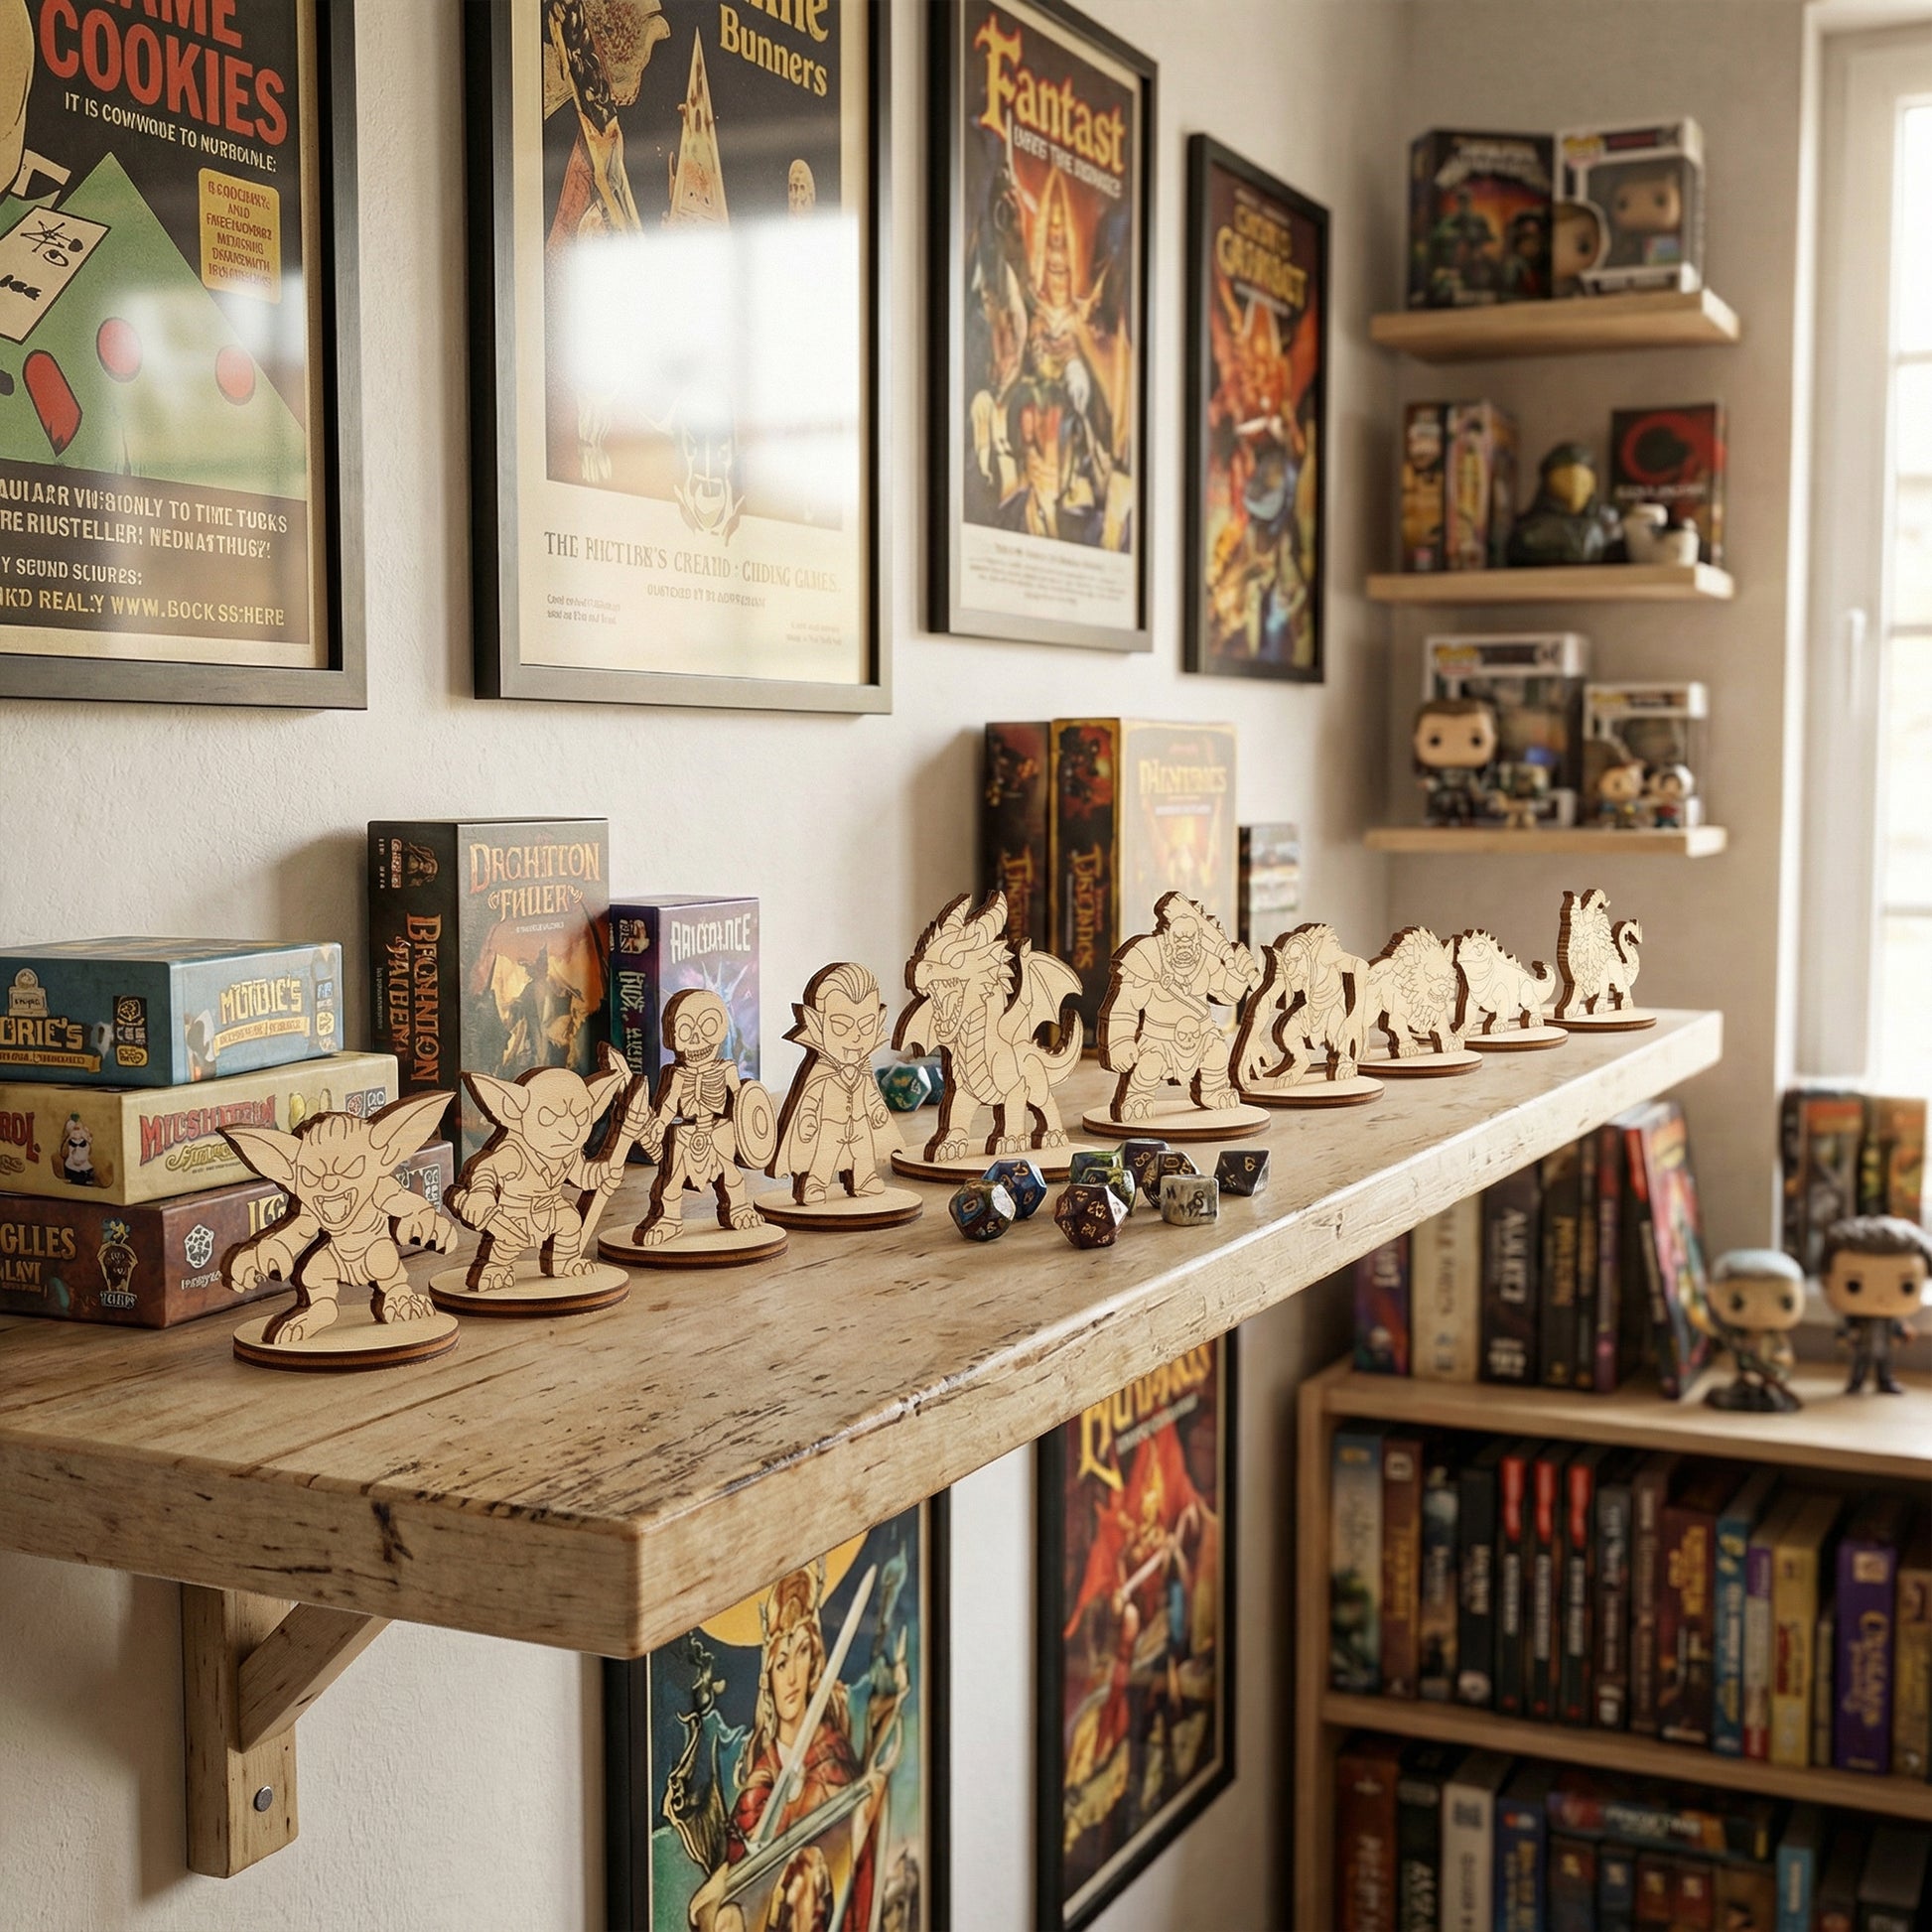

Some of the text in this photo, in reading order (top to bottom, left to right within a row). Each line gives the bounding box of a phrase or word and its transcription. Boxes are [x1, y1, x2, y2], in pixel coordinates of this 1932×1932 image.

[39, 0, 288, 146] COOKIES
[720, 3, 827, 97] Bunners
[65, 91, 79, 112] IT
[85, 98, 98, 118] IS
[180, 127, 197, 148] TO
[974, 13, 1125, 174] Fantast
[169, 500, 191, 521] TO
[544, 531, 579, 558] THE
